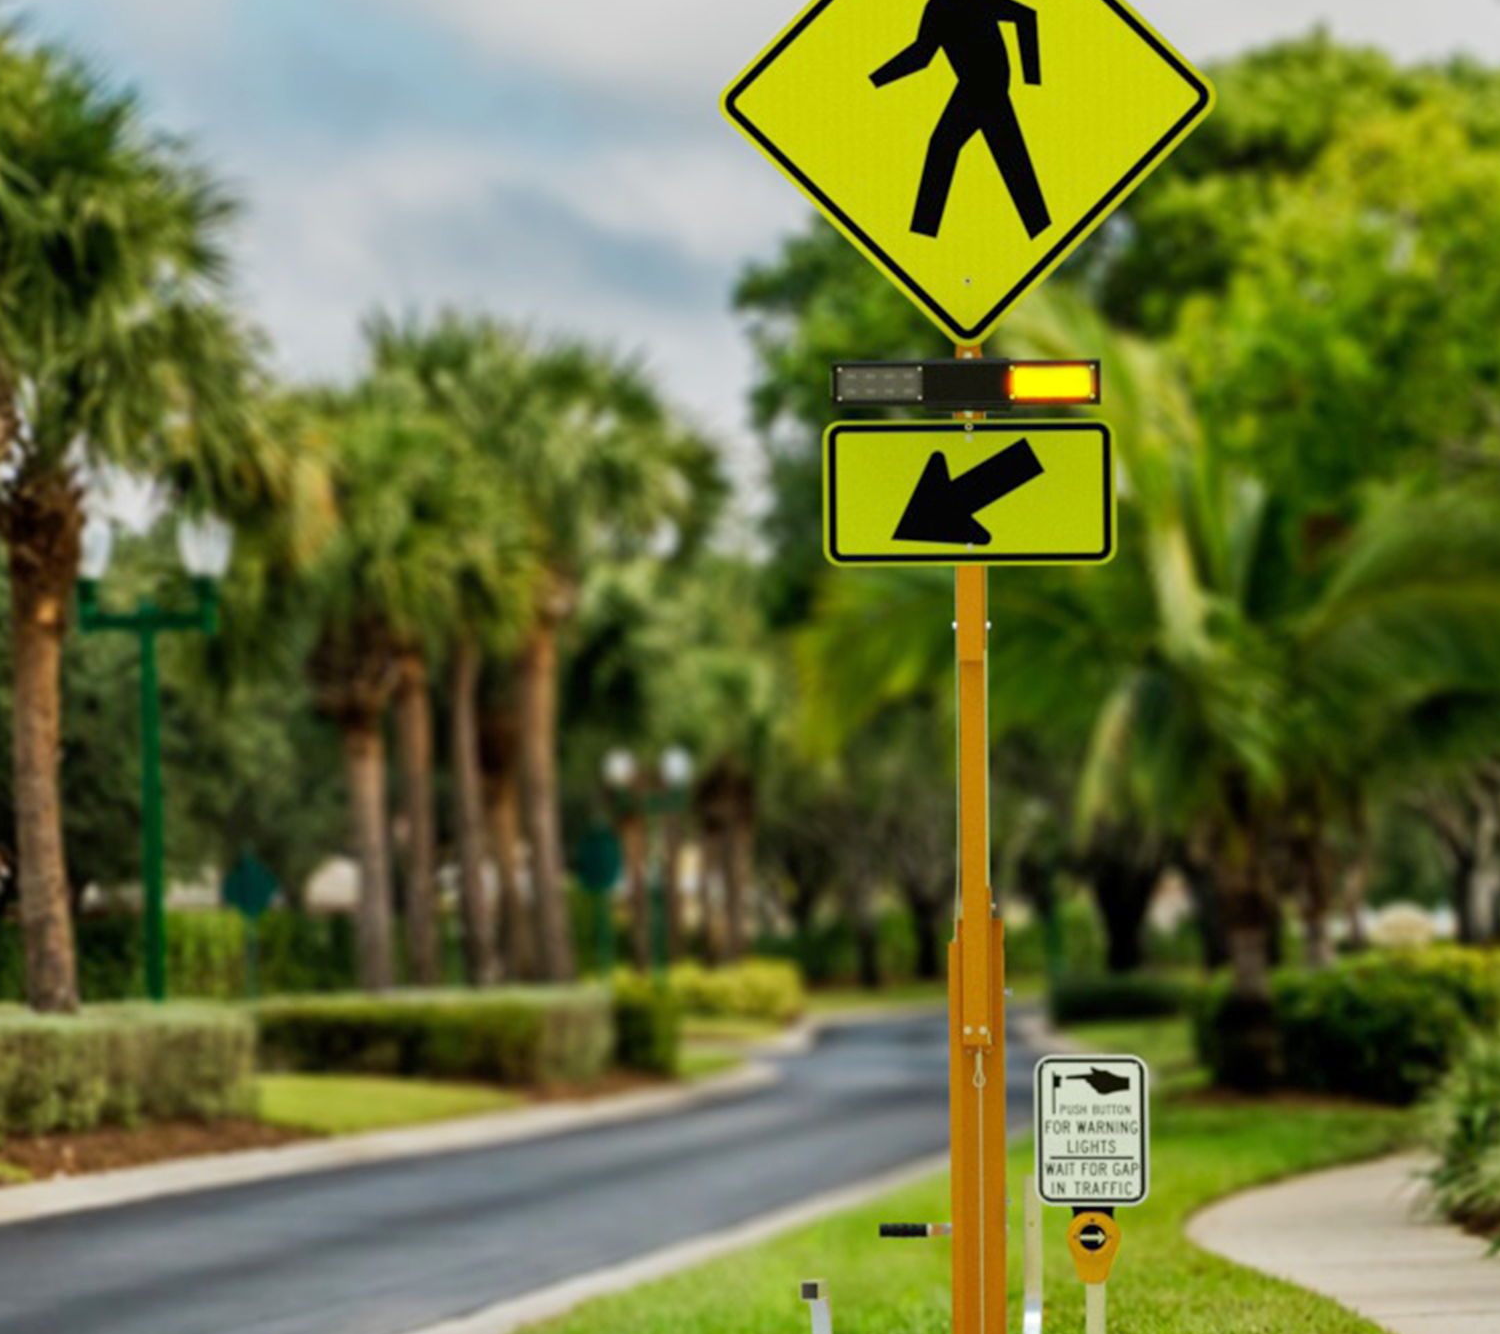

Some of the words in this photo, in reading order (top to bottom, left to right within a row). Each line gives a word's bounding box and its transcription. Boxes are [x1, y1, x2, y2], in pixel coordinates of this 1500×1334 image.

[1060, 1104, 1087, 1115] PUSH
[1092, 1104, 1131, 1115] BUTTON
[1045, 1120, 1071, 1134] FOR
[1077, 1120, 1138, 1134] WARNING
[1067, 1139, 1116, 1154] LIGHTS
[1046, 1162, 1075, 1176] WAIT
[1081, 1162, 1108, 1176] FOR
[1112, 1162, 1140, 1176] GAP
[1050, 1181, 1066, 1196] IN
[1074, 1181, 1133, 1196] TRAFFIC
